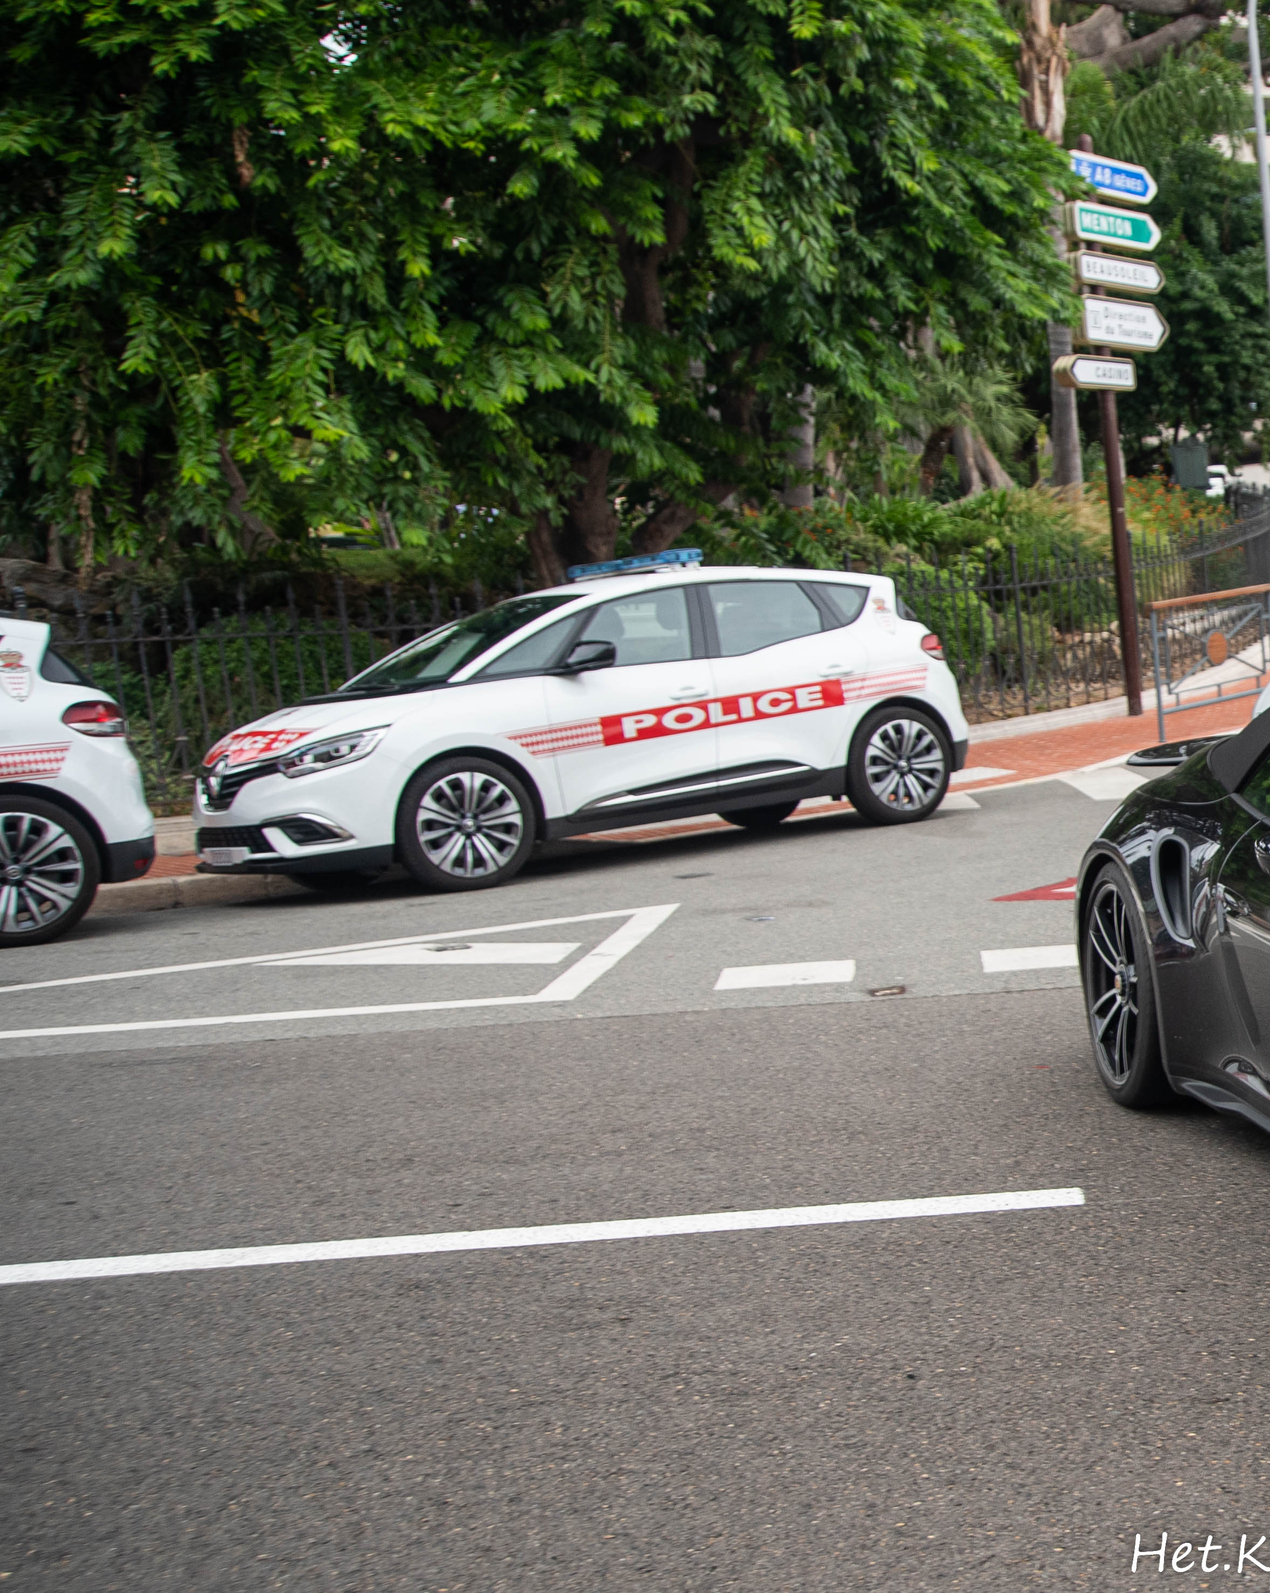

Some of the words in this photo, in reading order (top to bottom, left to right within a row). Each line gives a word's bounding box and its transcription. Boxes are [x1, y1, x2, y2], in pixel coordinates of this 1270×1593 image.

[1081, 211, 1133, 238] MENTON
[1086, 260, 1149, 283] BEAUSOLEIL
[1103, 306, 1147, 324] Direction
[1118, 324, 1154, 340] Tourisme
[1095, 366, 1129, 380] CASINO
[621, 685, 825, 738] POLICE
